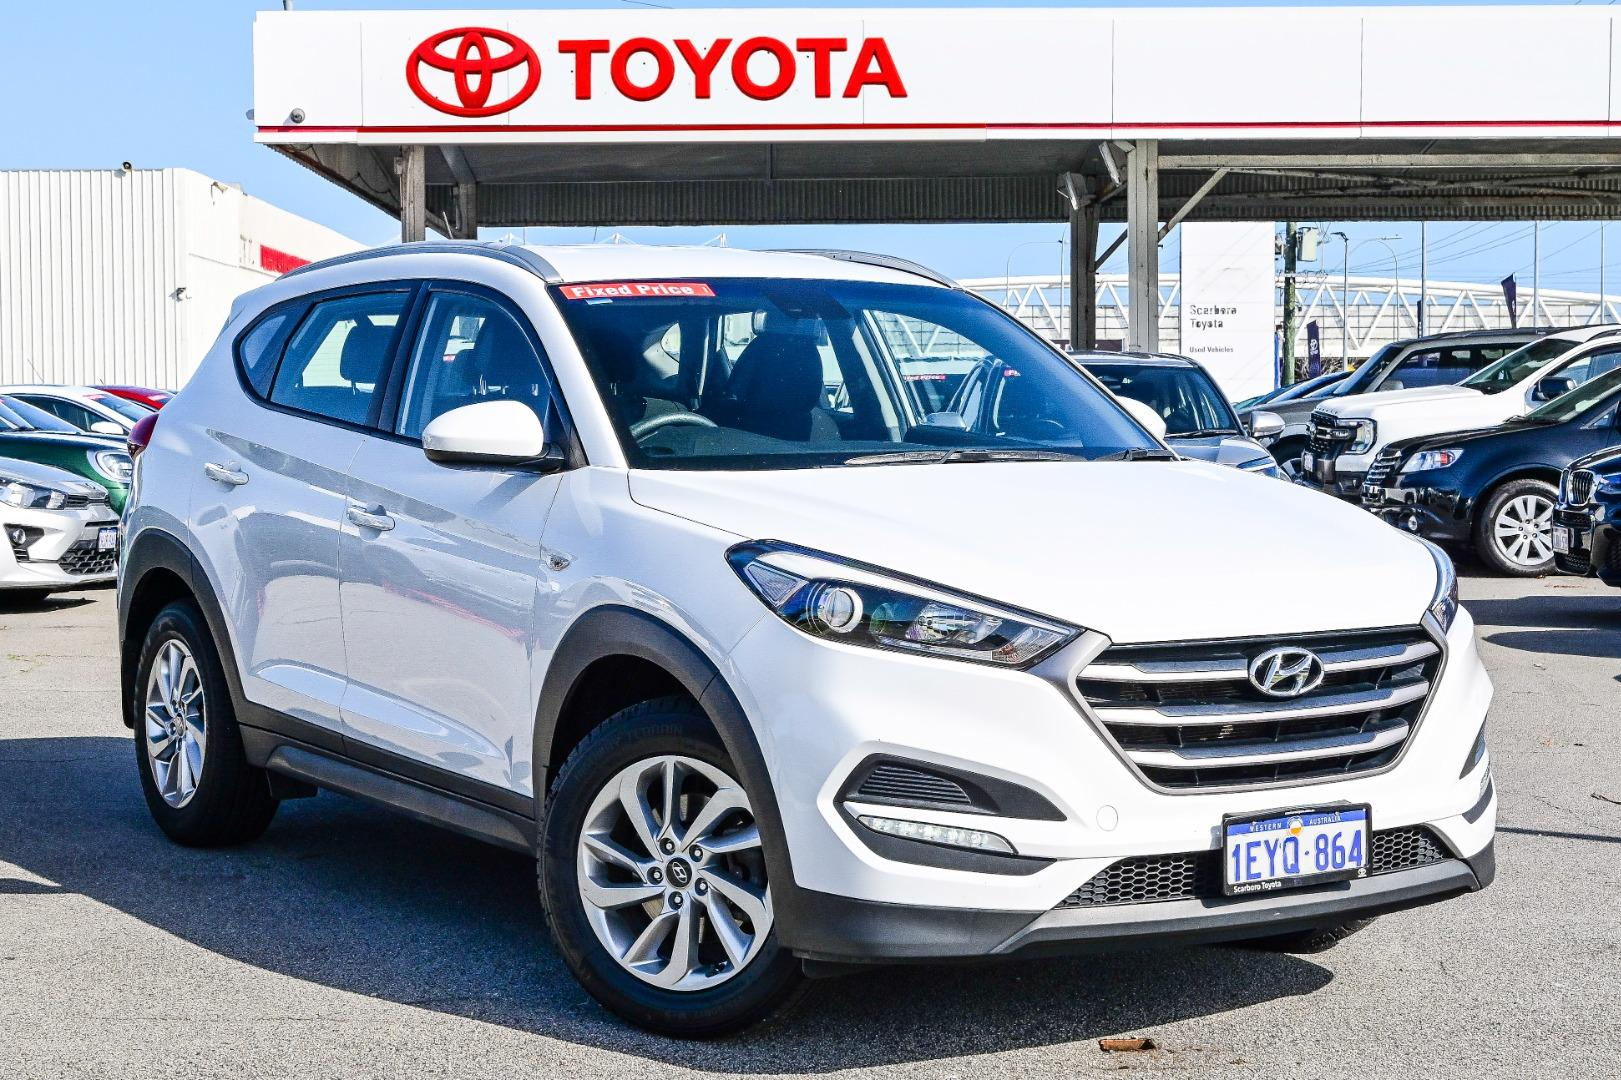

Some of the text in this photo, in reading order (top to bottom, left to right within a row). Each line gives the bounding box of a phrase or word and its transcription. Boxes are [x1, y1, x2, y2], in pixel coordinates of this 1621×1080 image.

[558, 36, 908, 102] TOYOTA
[570, 284, 694, 297] Fixed Price
[1249, 814, 1342, 833] WESTERN AUSTRALIA
[1233, 880, 1282, 893] Scarboro Toyota
